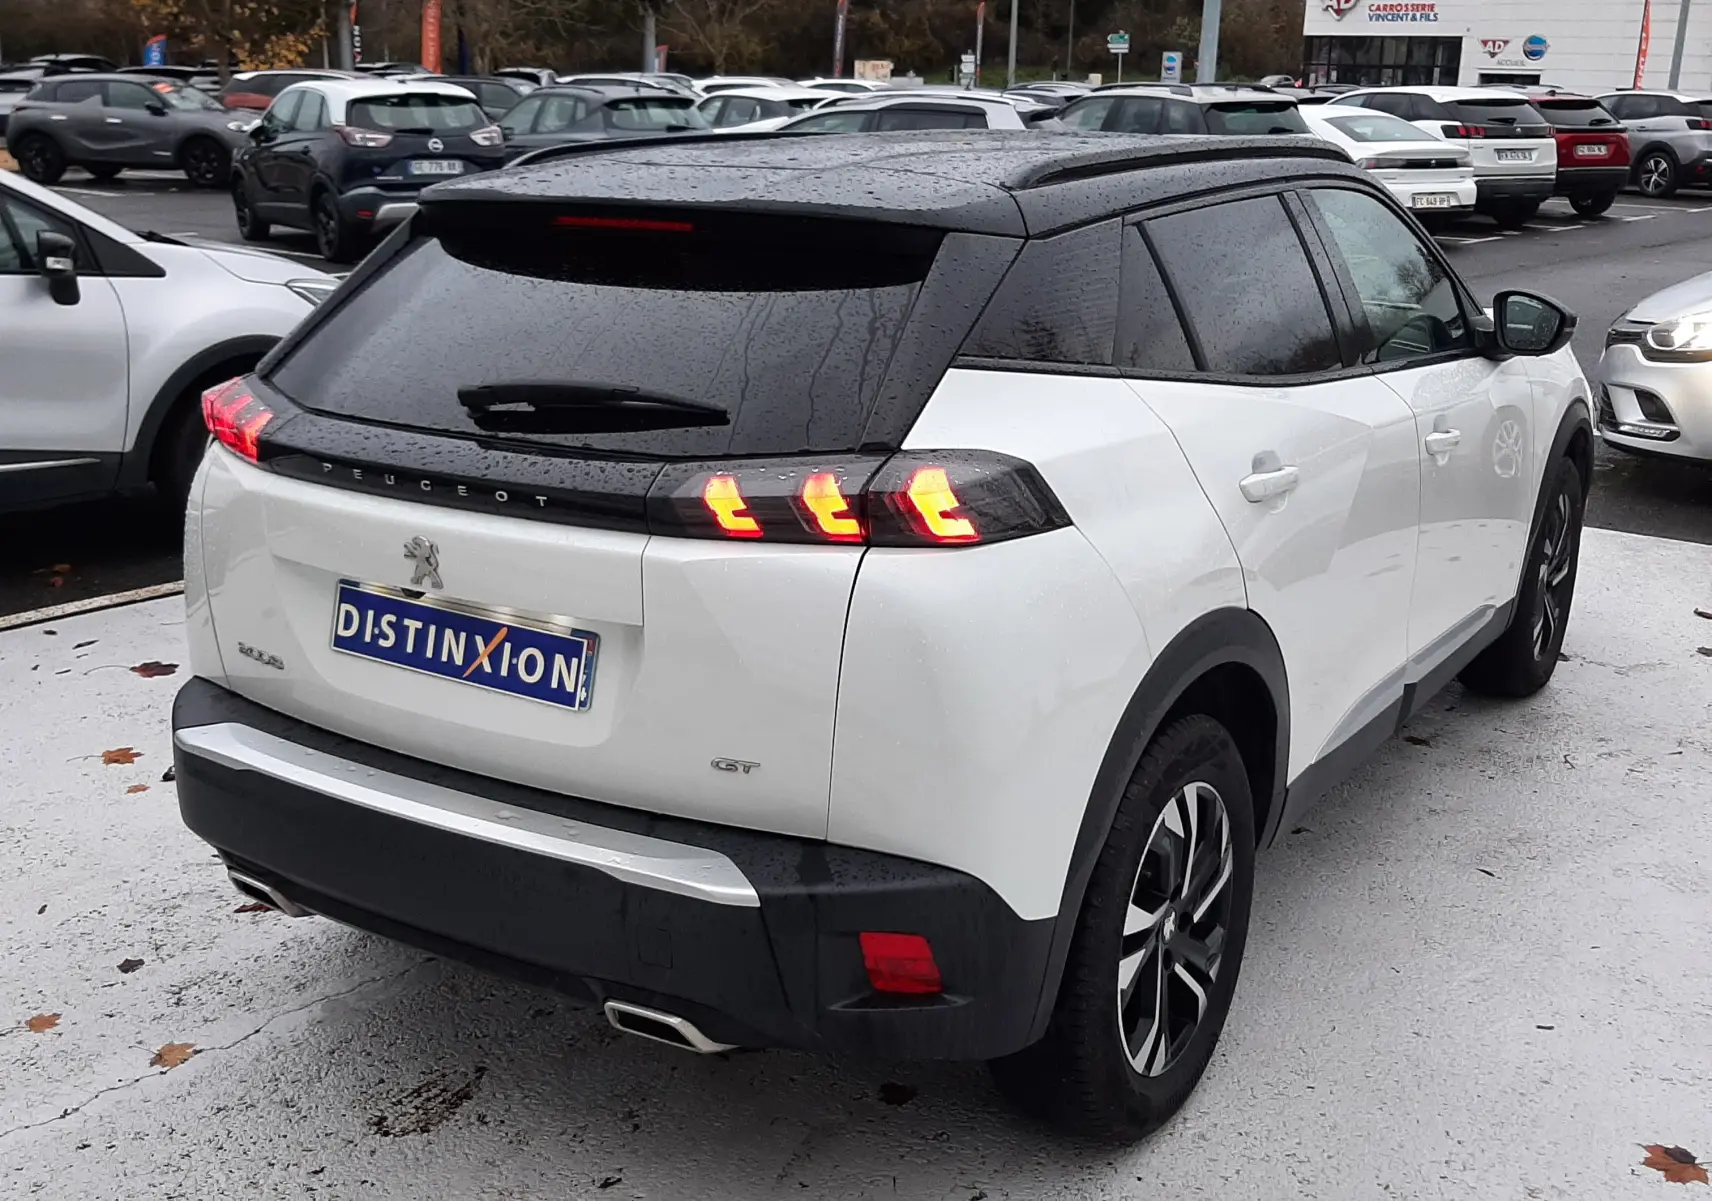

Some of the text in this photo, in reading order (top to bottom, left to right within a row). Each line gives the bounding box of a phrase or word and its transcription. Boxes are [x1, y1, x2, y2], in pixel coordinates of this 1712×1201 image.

[1368, 3, 1436, 12] CARROSSERIE
[1368, 13, 1410, 22] VINCENT
[1420, 13, 1439, 22] FILS
[1483, 40, 1505, 53] AD
[321, 462, 548, 508] PEUGEOT
[335, 602, 580, 693] DISTINXION
[710, 756, 761, 774] GT
